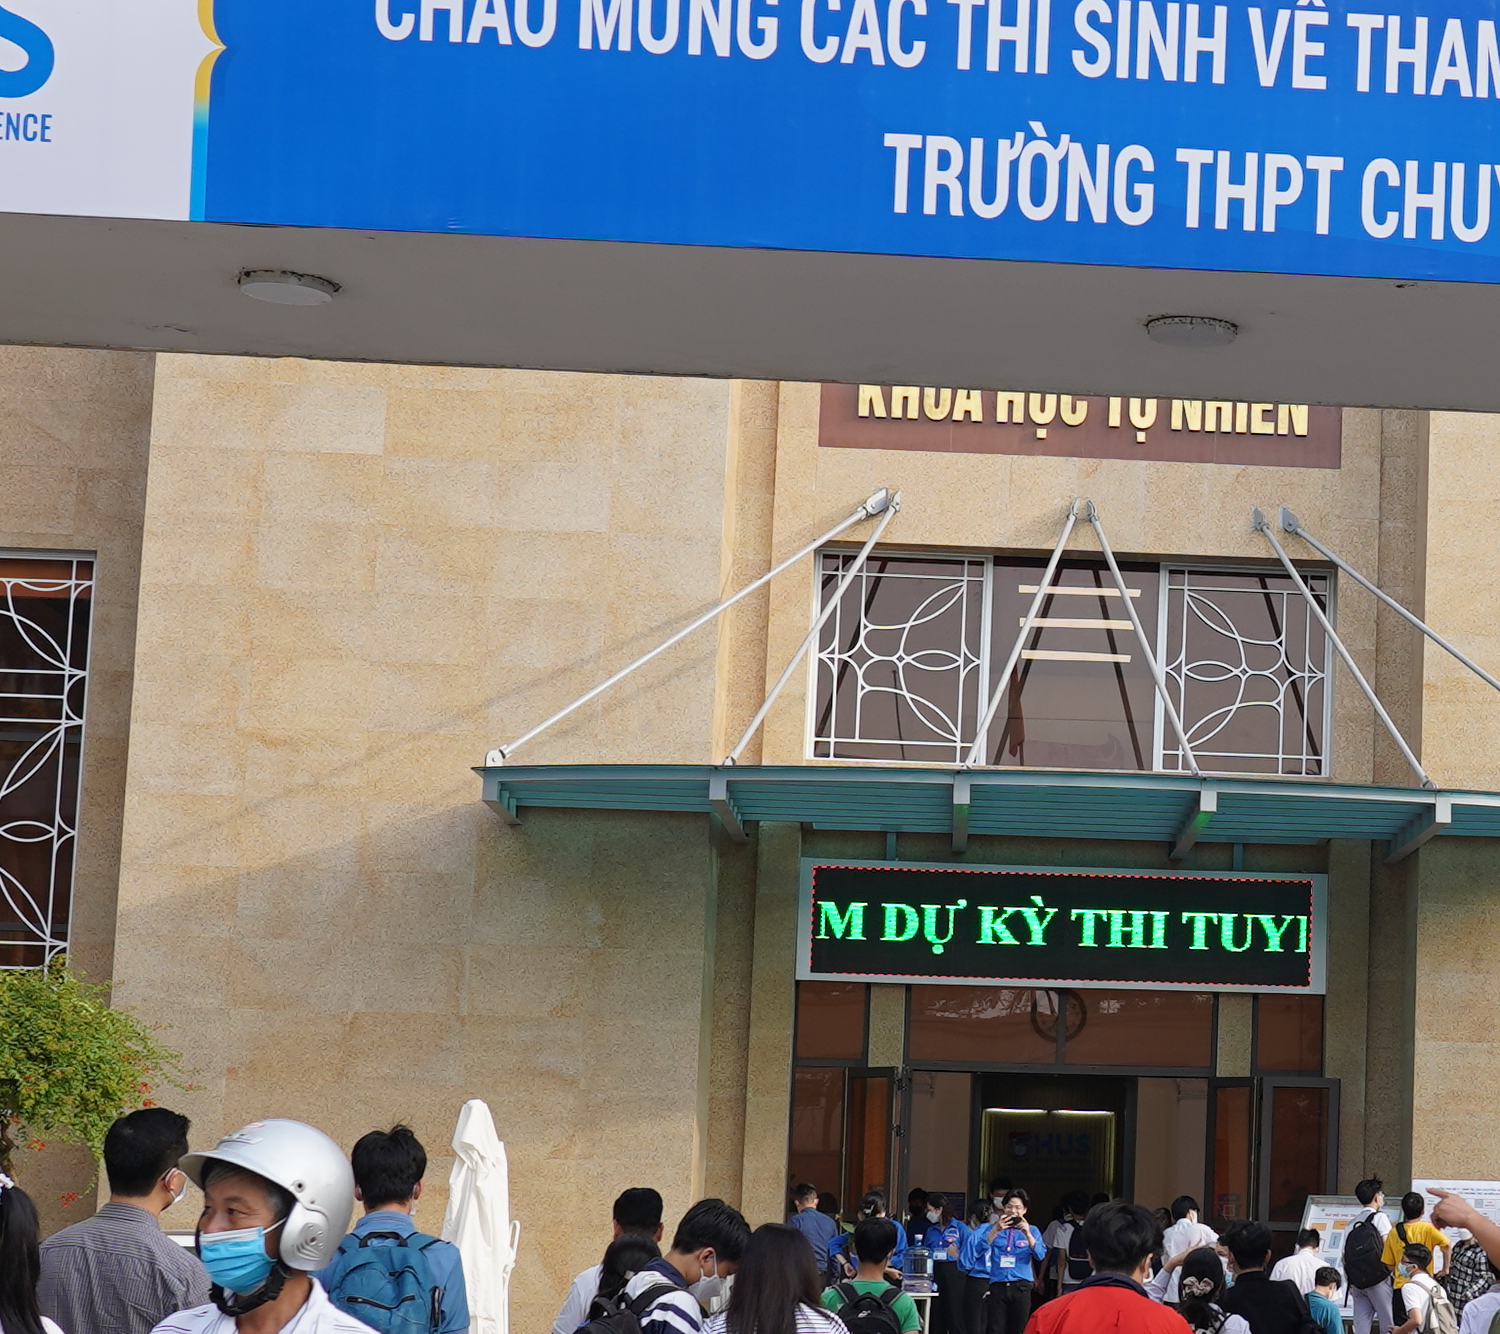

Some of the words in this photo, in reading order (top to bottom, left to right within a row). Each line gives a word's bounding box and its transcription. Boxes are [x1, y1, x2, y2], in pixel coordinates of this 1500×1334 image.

[884, 120, 1155, 226] TRƯỜNG
[1176, 148, 1343, 235] THPT
[815, 901, 868, 941] M
[881, 898, 968, 955] DỰ
[976, 895, 1059, 946] KỲ
[1070, 908, 1170, 950] THI
